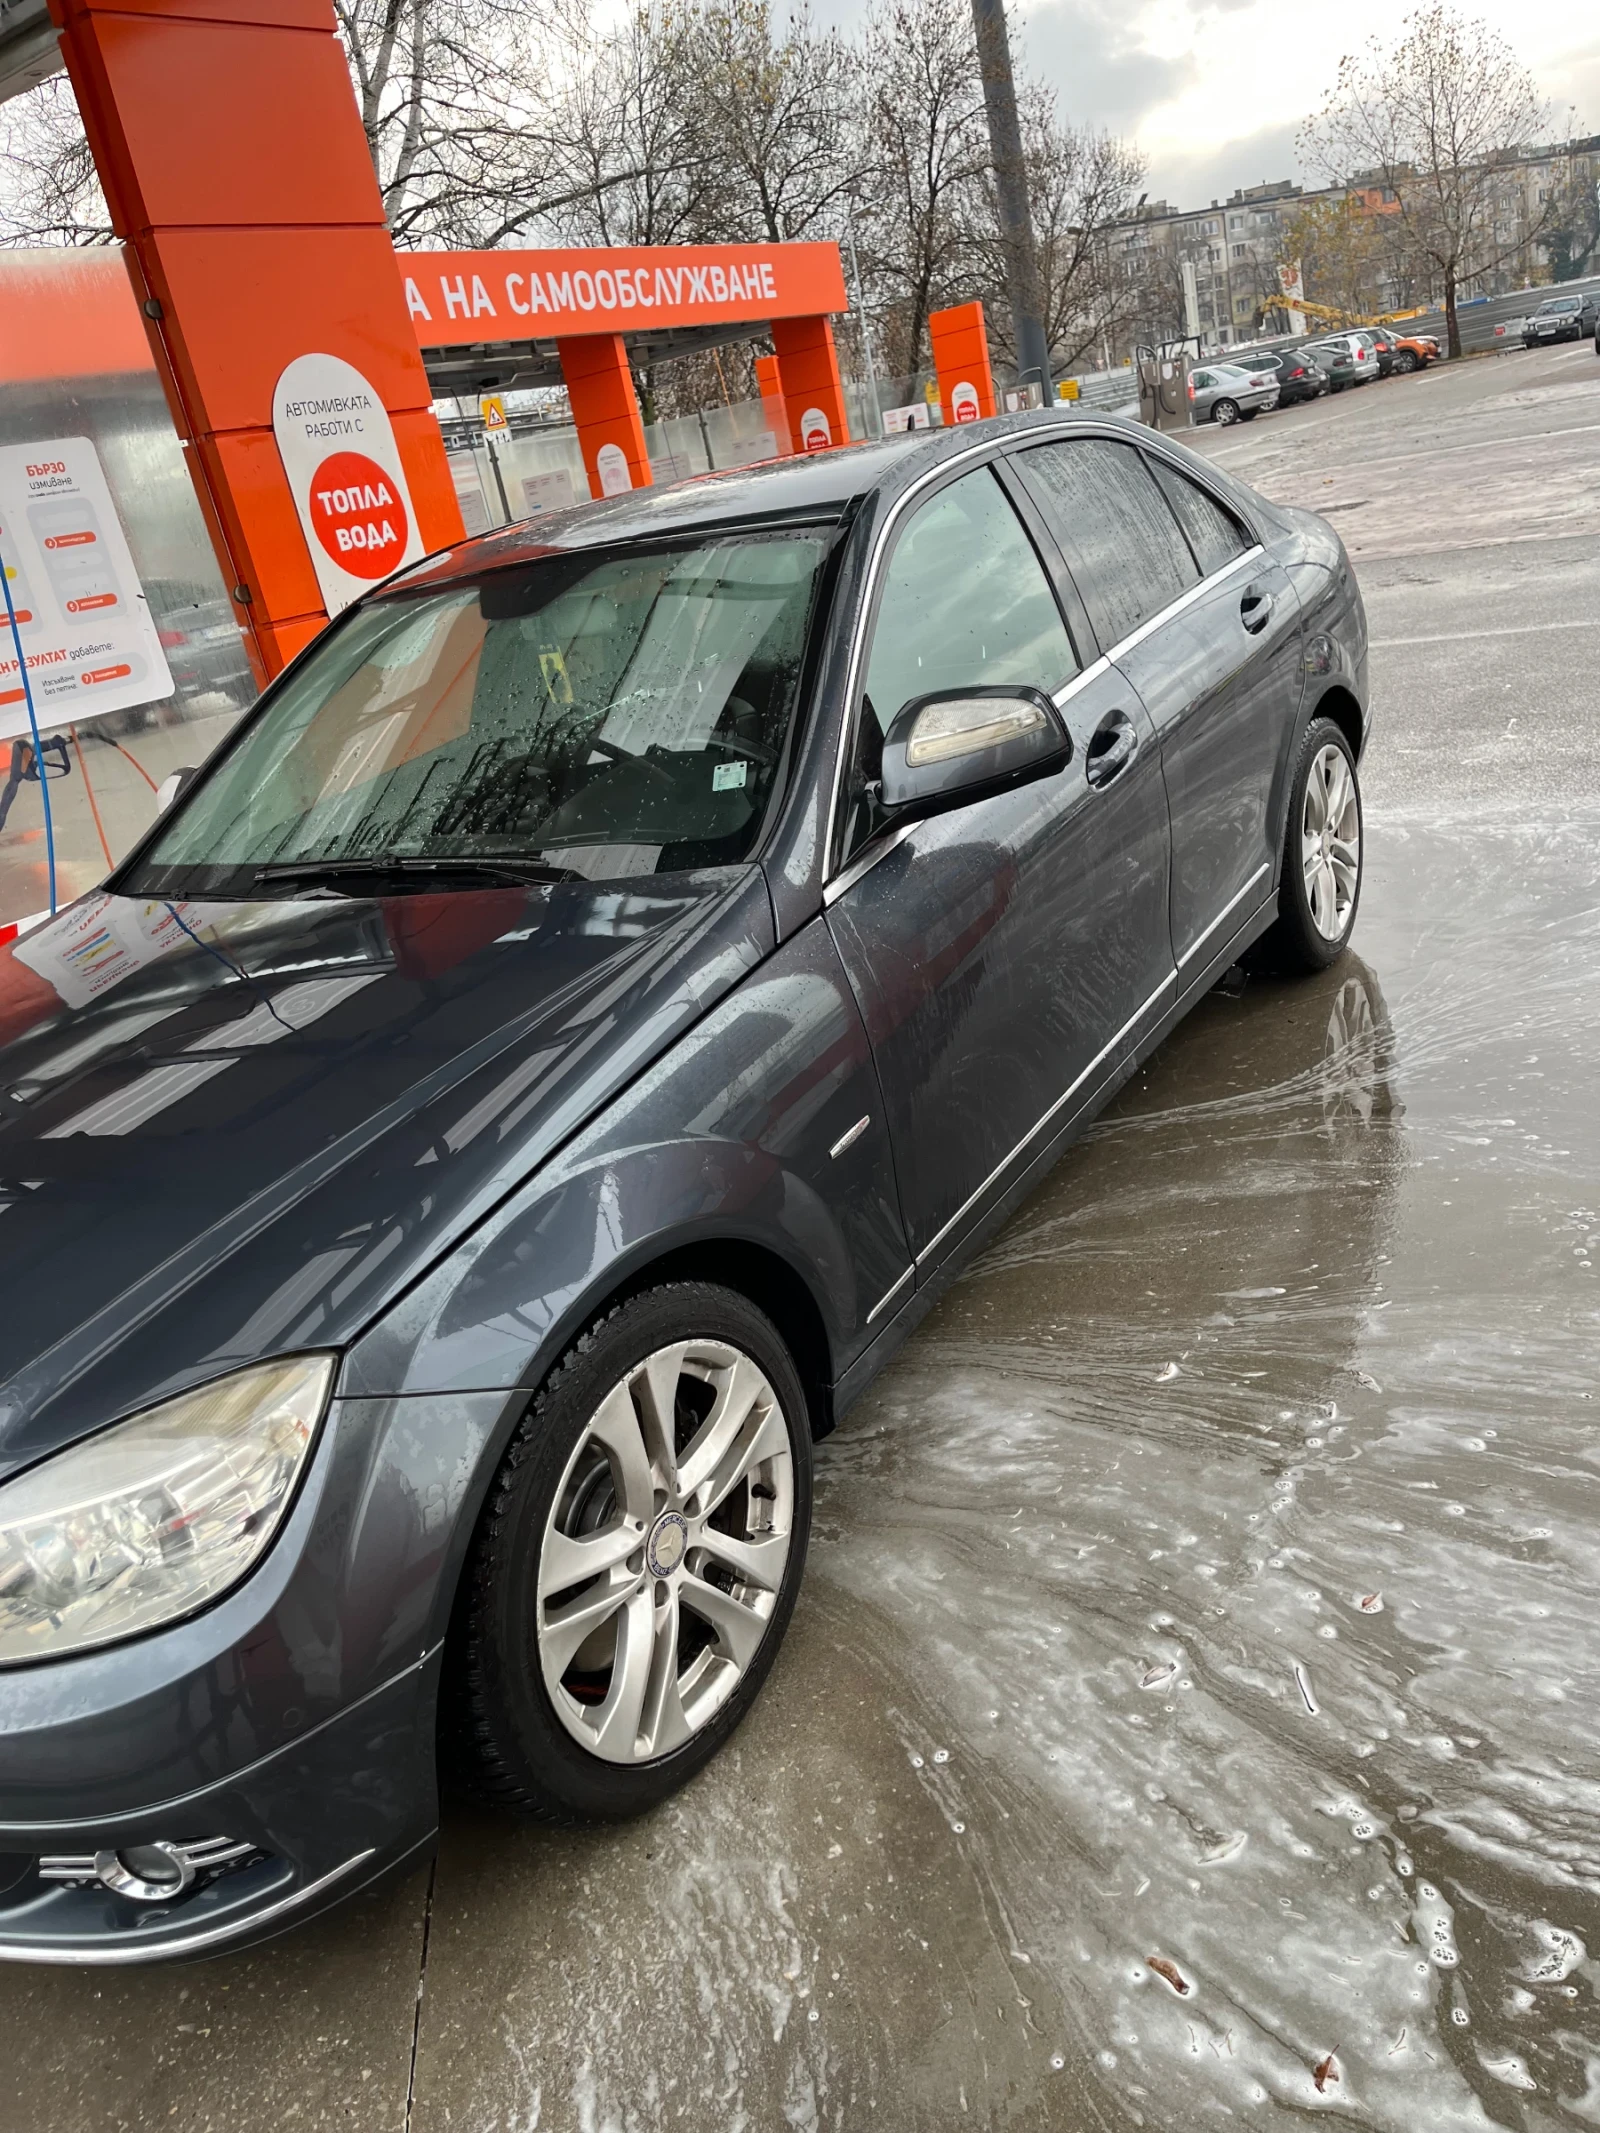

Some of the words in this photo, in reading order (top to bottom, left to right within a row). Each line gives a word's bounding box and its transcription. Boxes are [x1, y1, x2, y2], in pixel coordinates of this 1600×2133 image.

[440, 274, 497, 319] НА
[505, 263, 778, 316] САМООБСЛУЖВАНЕ
[285, 395, 372, 419] АВТОМИВКАТА
[305, 420, 354, 439] РАБОТИ
[355, 418, 365, 433] С
[25, 461, 66, 477] БЪРЗО
[28, 476, 73, 490] измиване
[317, 482, 394, 516] ТОПЛА
[335, 520, 397, 552] ВОДА
[69, 641, 115, 661] добавете:
